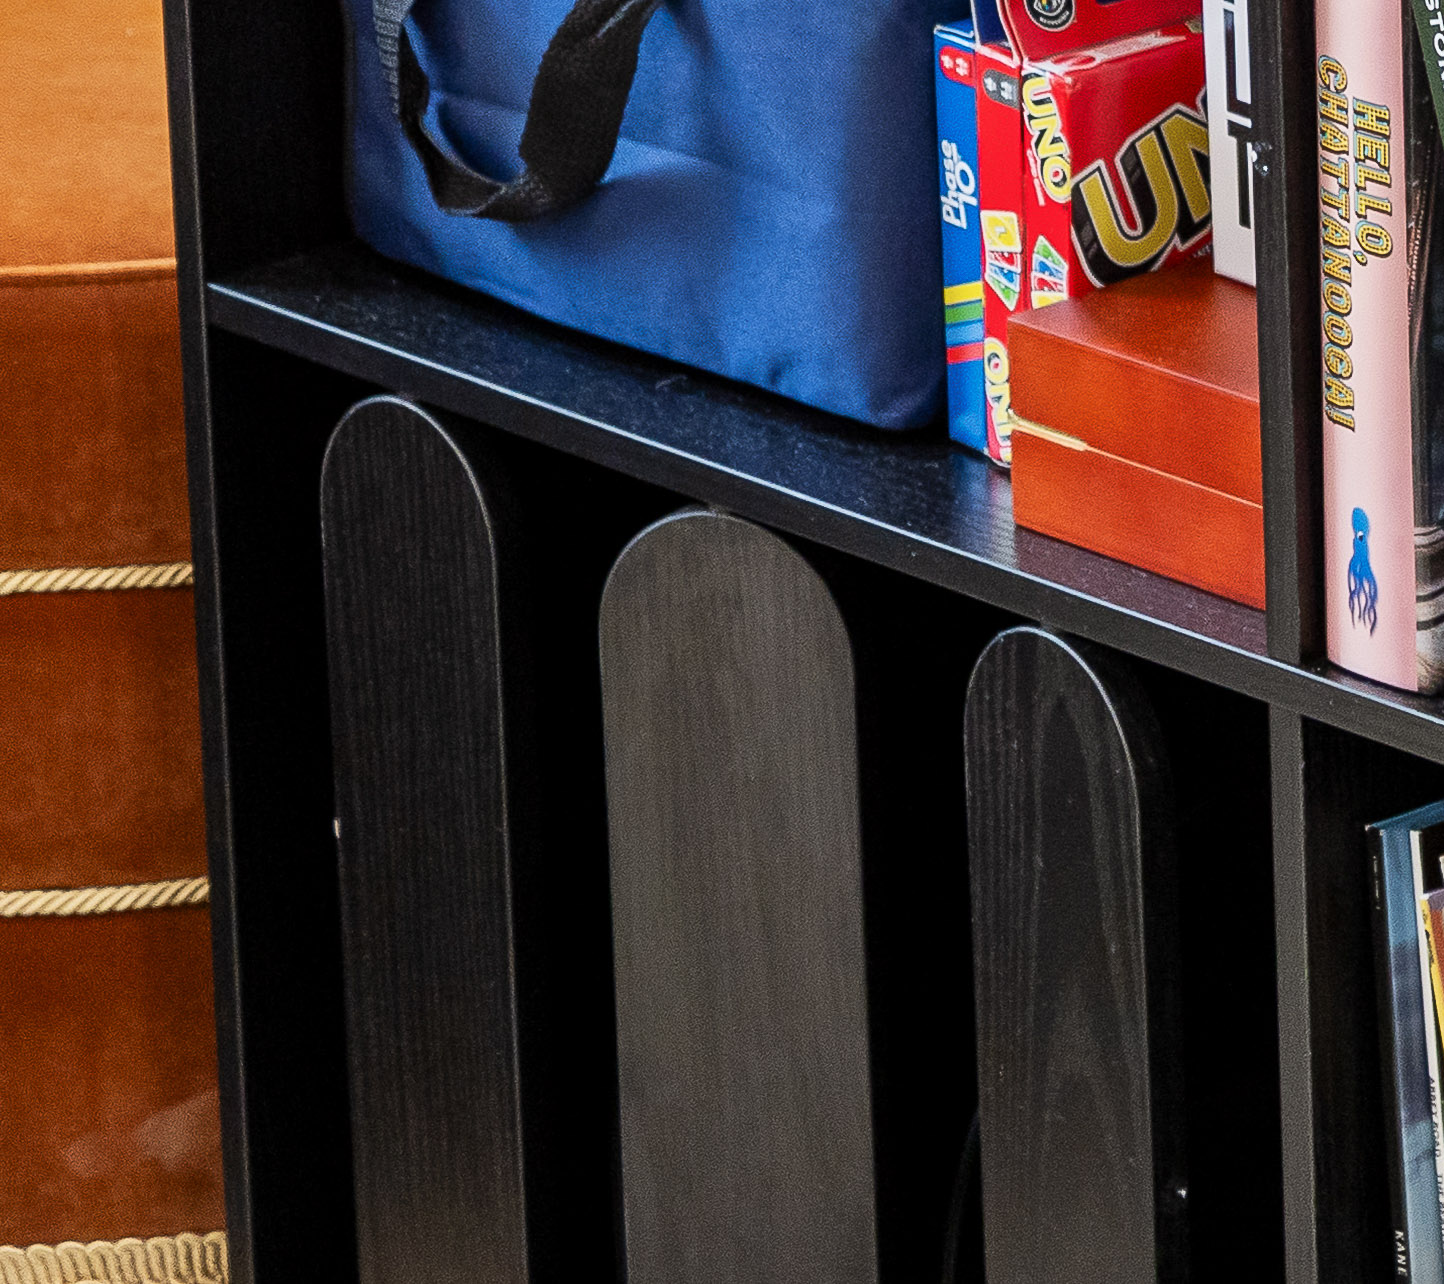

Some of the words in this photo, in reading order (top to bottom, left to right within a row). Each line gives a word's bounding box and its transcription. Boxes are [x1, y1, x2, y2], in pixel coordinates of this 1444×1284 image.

[941, 138, 967, 230] Phase
[1022, 72, 1073, 203] UNO
[1353, 96, 1393, 268] HELLO,
[1318, 53, 1356, 433] CHATTANOOGA!
[1394, 1229, 1409, 1276] KANE
